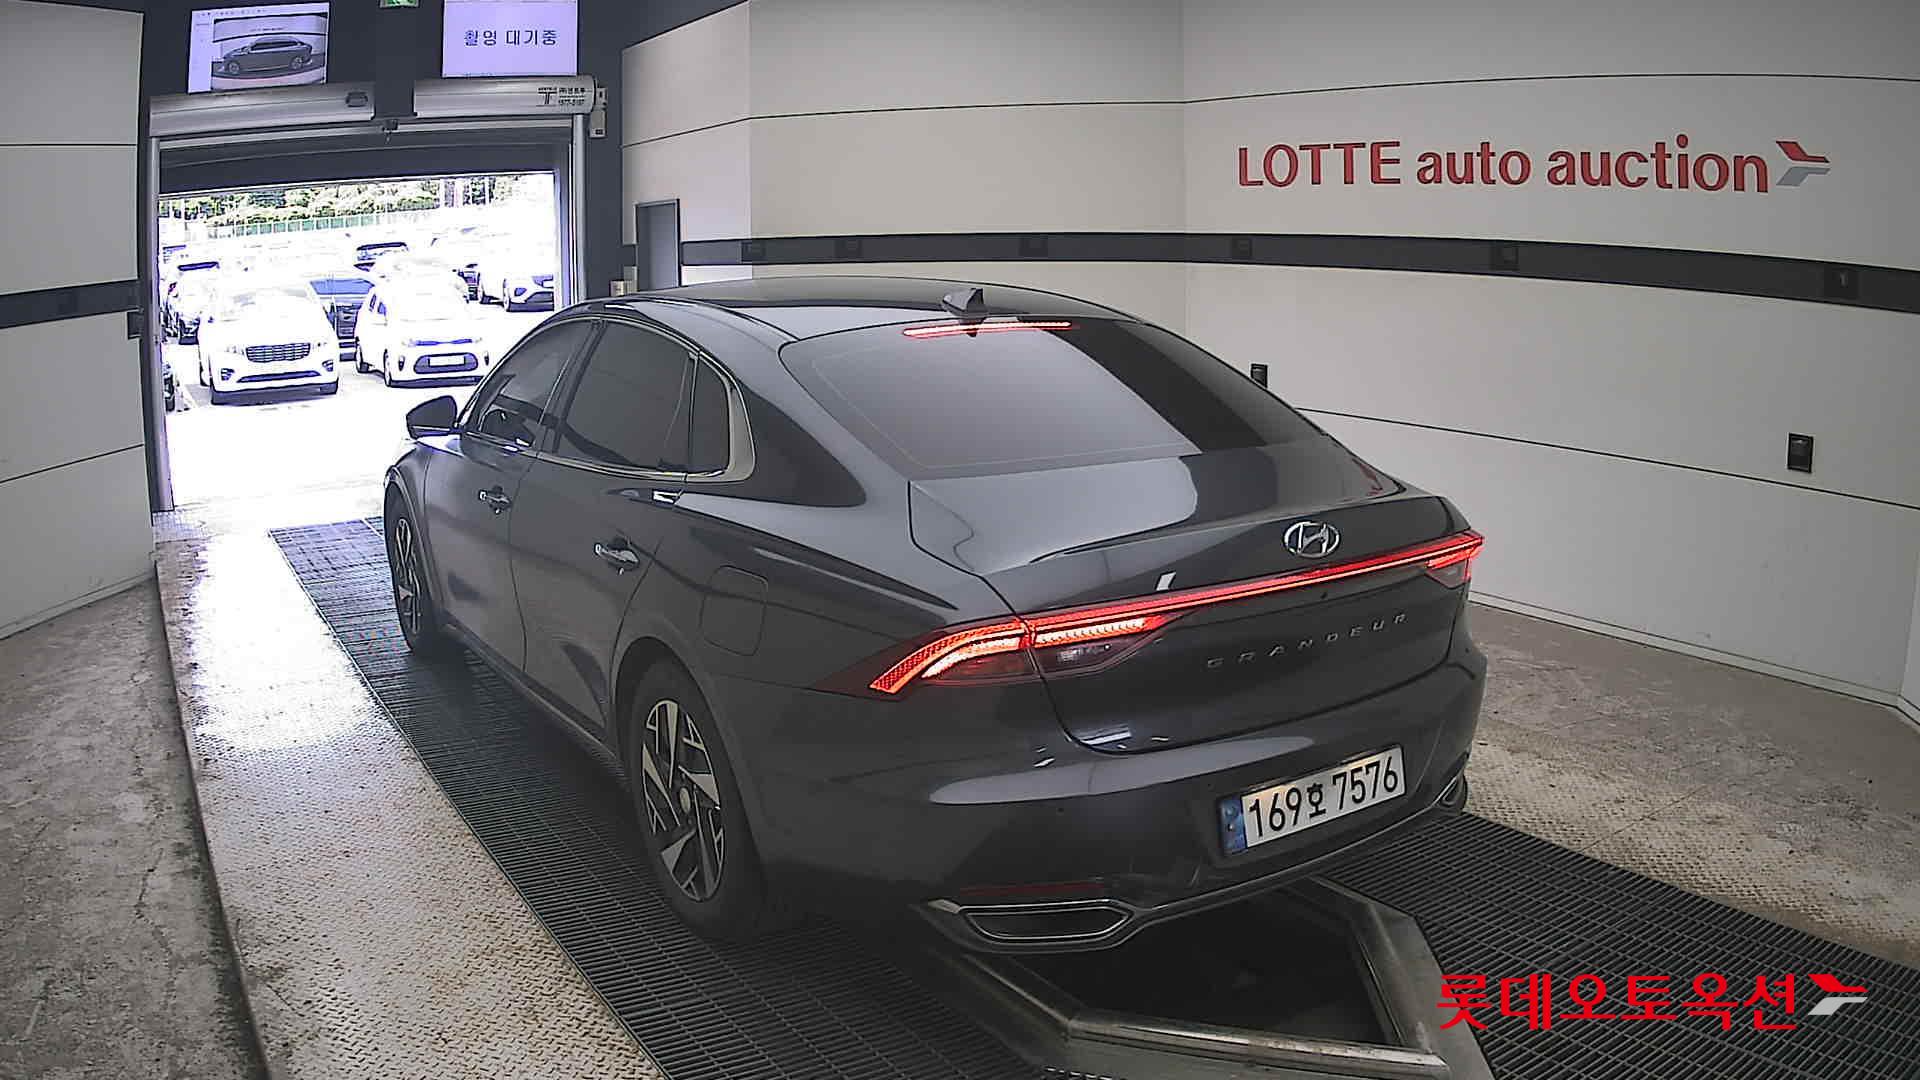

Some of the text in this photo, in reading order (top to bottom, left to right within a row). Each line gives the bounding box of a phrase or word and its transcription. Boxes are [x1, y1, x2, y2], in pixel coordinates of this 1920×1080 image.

[505, 29, 557, 46] 대기중
[1238, 134, 1769, 194] LOTTE auto auction
[1207, 611, 1408, 668] GRANDEUR
[1248, 756, 1399, 838] 169호 7576
